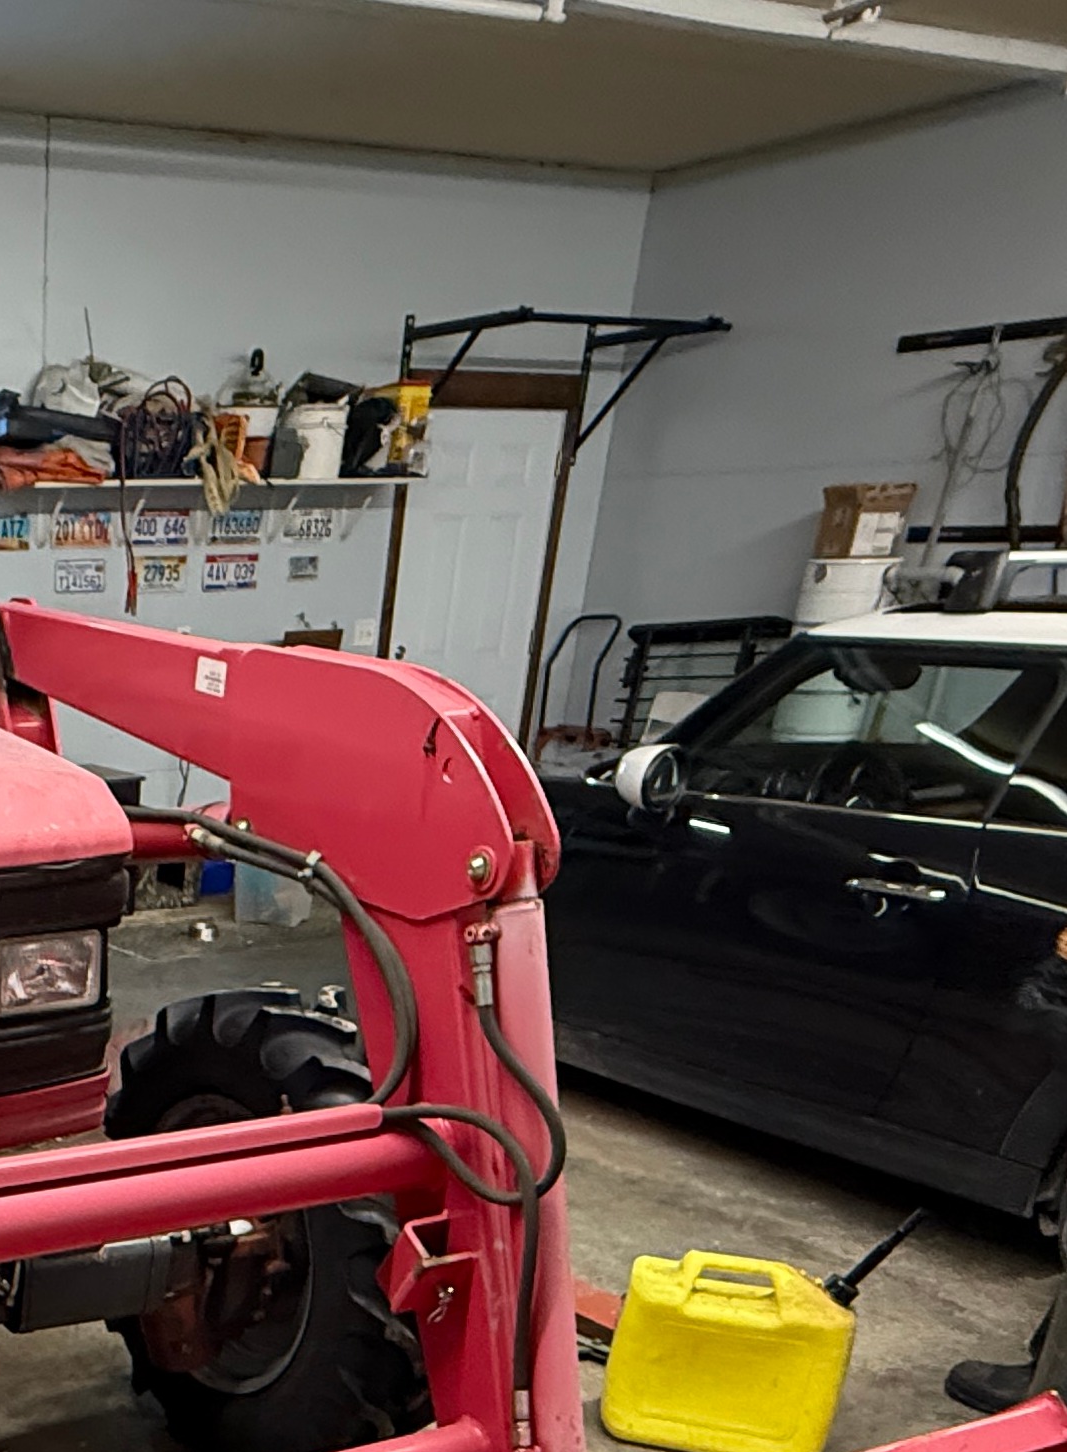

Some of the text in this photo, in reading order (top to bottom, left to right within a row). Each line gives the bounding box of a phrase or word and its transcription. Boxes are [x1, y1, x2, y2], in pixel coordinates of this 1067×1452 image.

[164, 518, 186, 535] 646
[143, 564, 180, 582] 27935
[234, 563, 255, 580] 039
